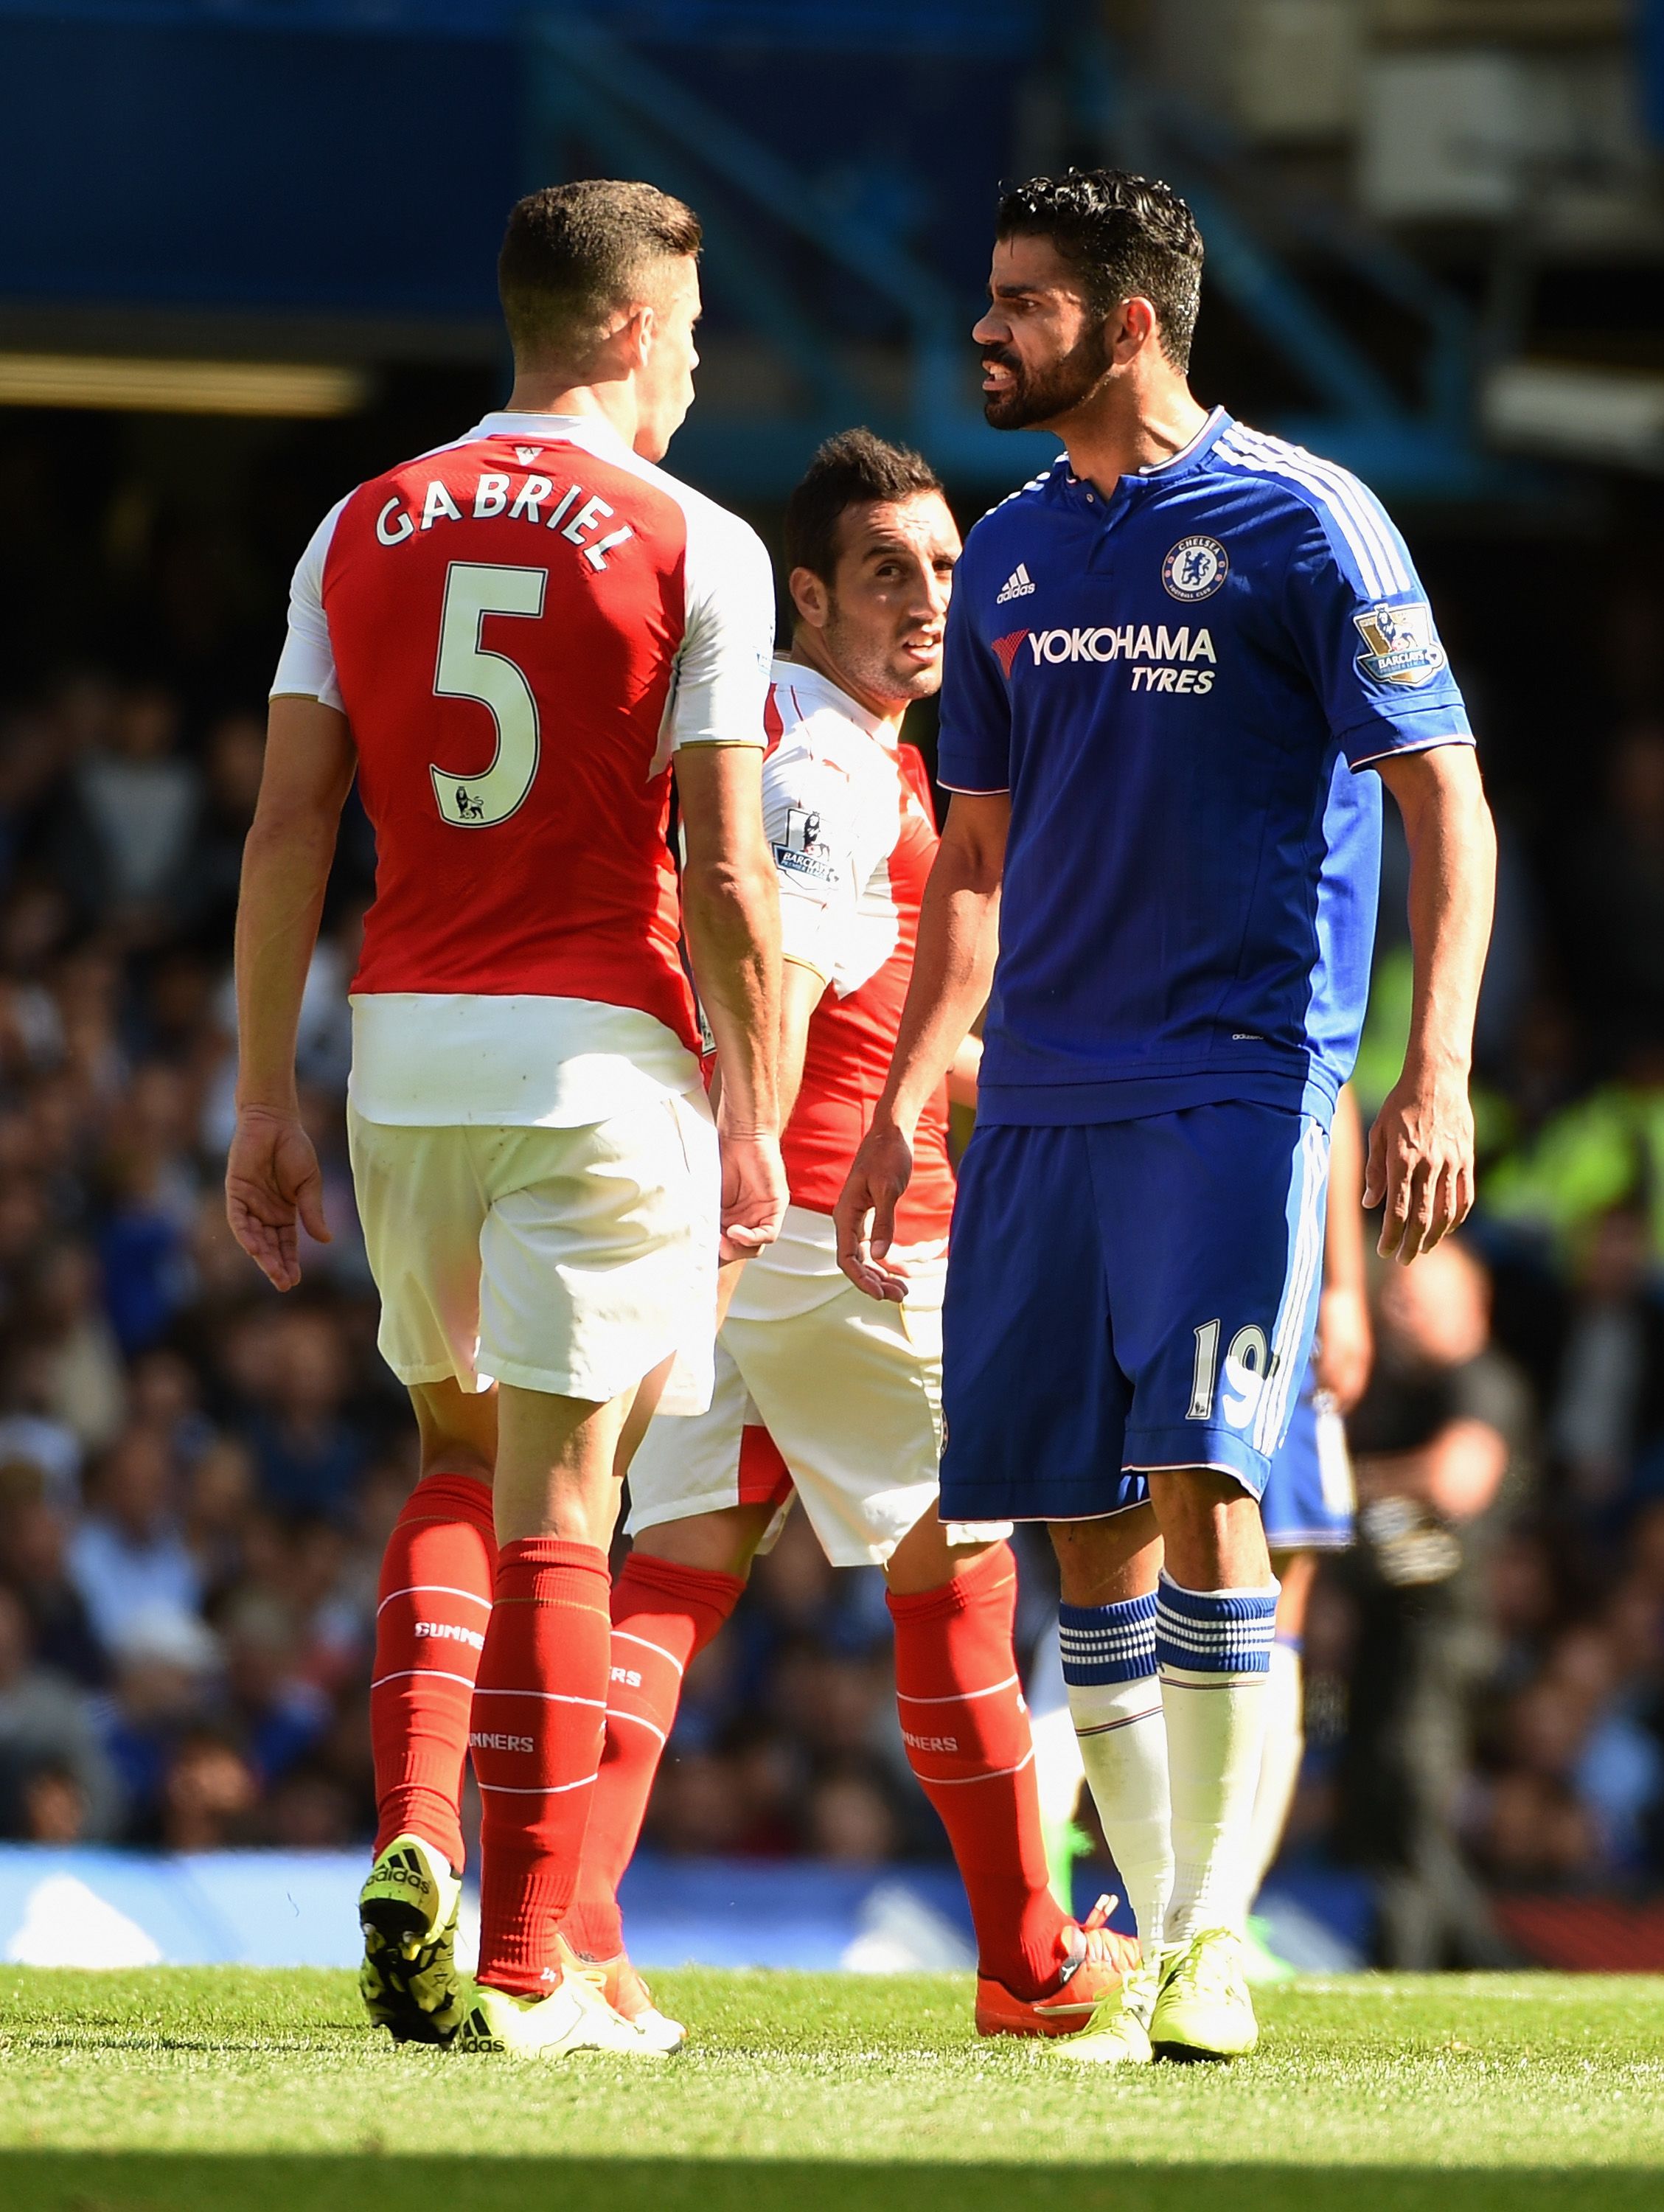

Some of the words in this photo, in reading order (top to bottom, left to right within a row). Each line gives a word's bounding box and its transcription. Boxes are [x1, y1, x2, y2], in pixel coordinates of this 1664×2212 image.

[375, 473, 633, 571] GABRIEL
[1178, 538, 1220, 554] CHELSEA
[996, 582, 1036, 605] adidas
[1028, 625, 1216, 665] YOKOHAMA
[1377, 649, 1424, 669] BARCLAYS
[429, 560, 549, 828] 5
[1131, 667, 1216, 695] TYRES
[1185, 1318, 1281, 1429] 19
[609, 1666, 641, 1687] RS
[366, 1867, 431, 1894] adidas
